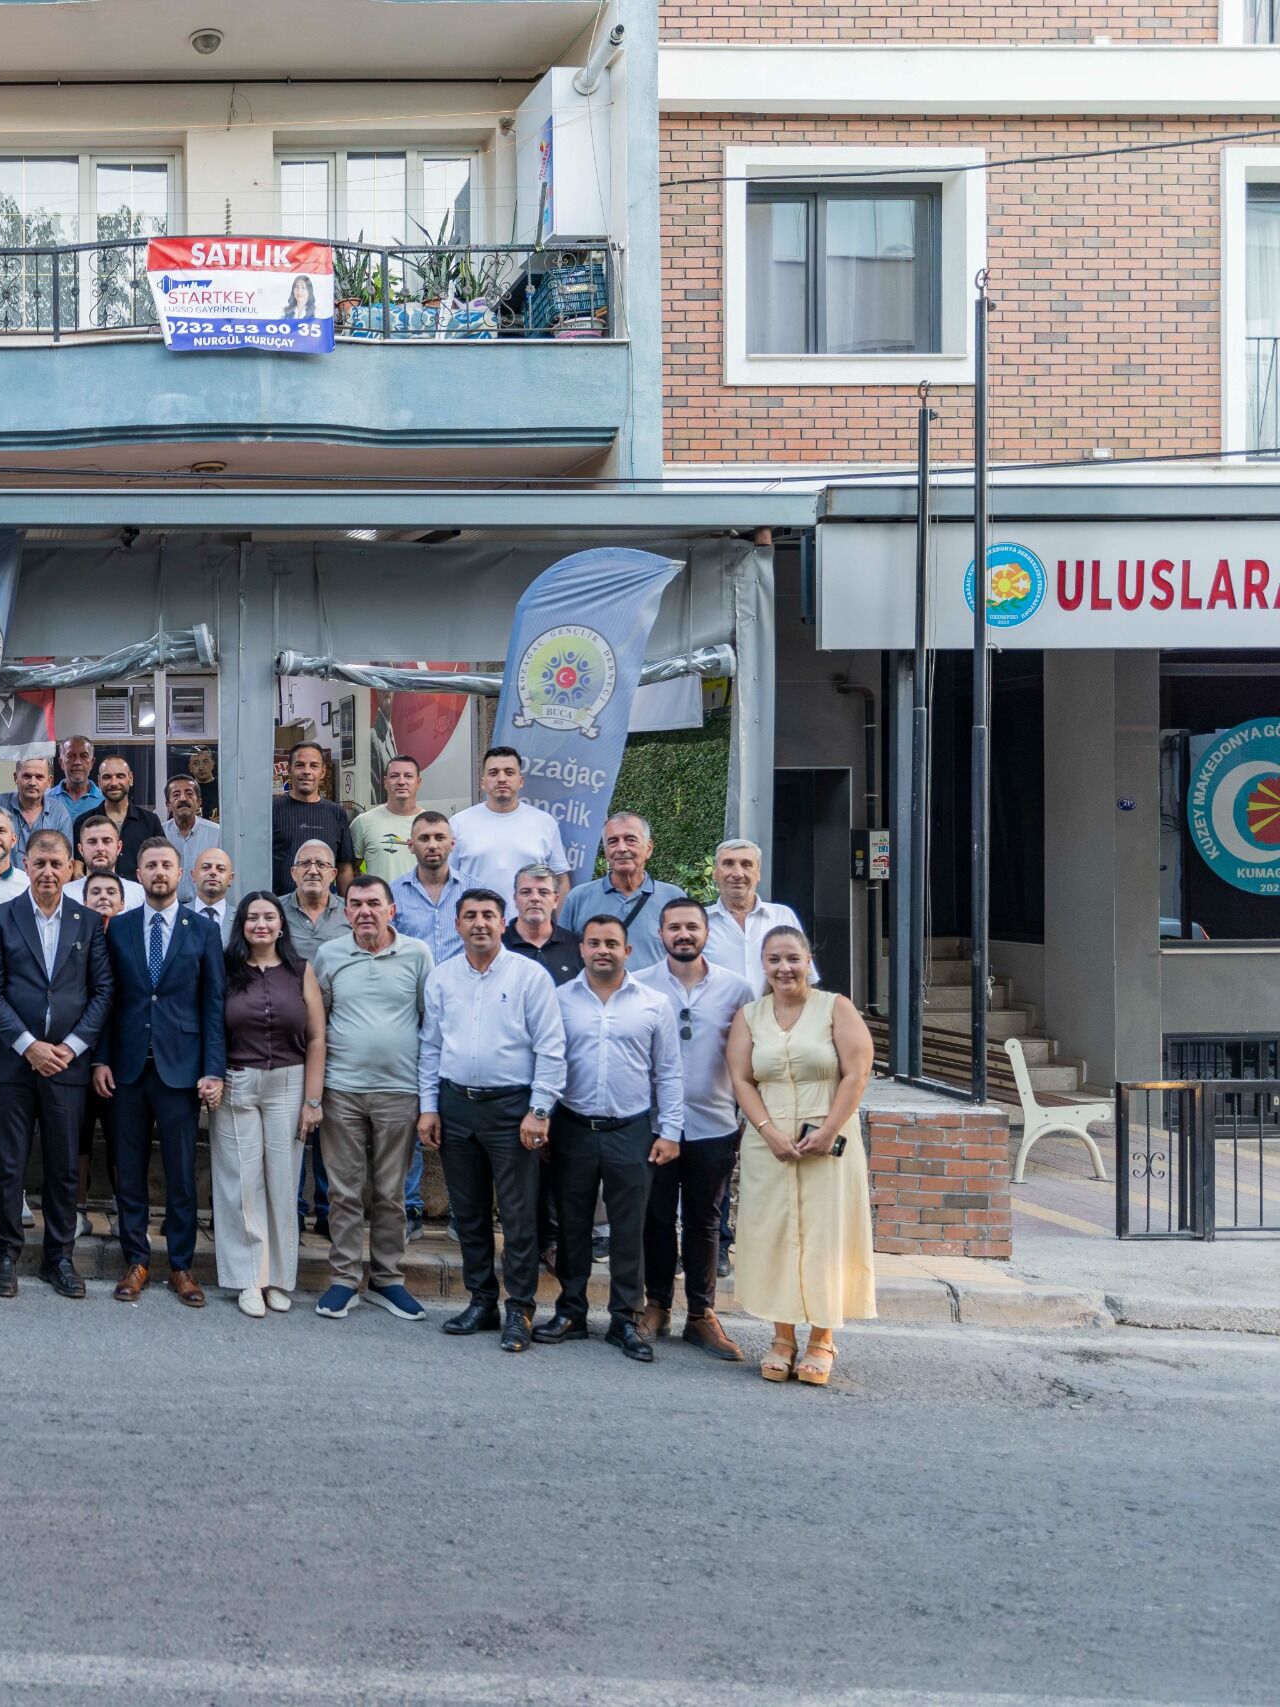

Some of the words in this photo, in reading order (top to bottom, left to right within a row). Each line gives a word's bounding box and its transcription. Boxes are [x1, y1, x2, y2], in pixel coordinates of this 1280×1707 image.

[191, 243, 293, 267] SATILIK
[168, 291, 256, 305] STARTKEY
[220, 324, 260, 334] 453
[265, 324, 291, 335] 00
[297, 323, 322, 338] 35
[193, 334, 242, 347] NURGÜL
[244, 335, 295, 348] KURUÇAY
[1192, 726, 1263, 806] MAKEDONYA
[1194, 809, 1220, 860] KUZEY
